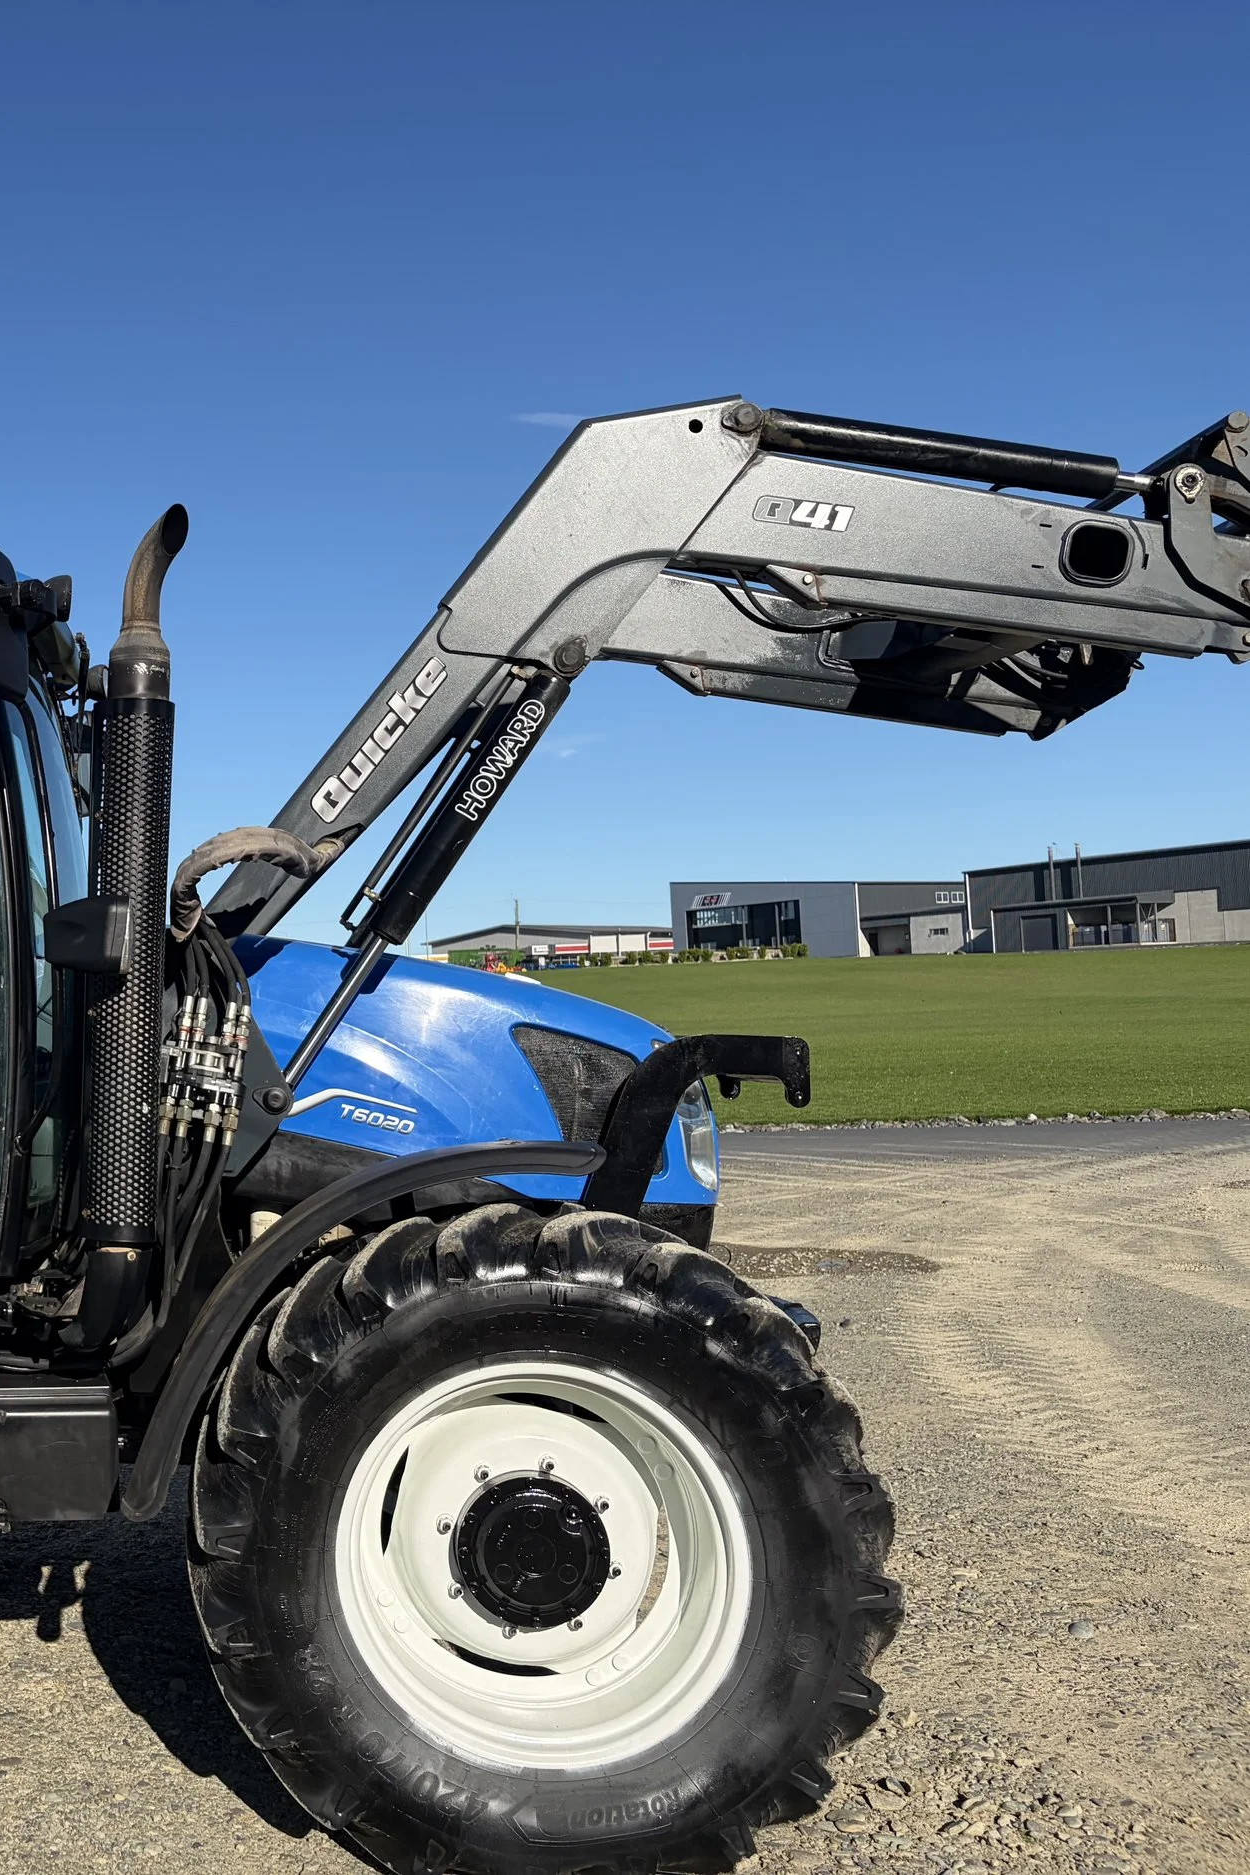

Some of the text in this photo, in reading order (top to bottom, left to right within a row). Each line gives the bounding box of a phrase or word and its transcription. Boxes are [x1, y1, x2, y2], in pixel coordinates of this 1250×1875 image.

[310, 656, 448, 824] Quicke
[454, 699, 546, 821] HOWARD
[341, 1104, 415, 1135] T6020
[294, 1643, 341, 1696] 28
[356, 1729, 490, 1826] 420/70
